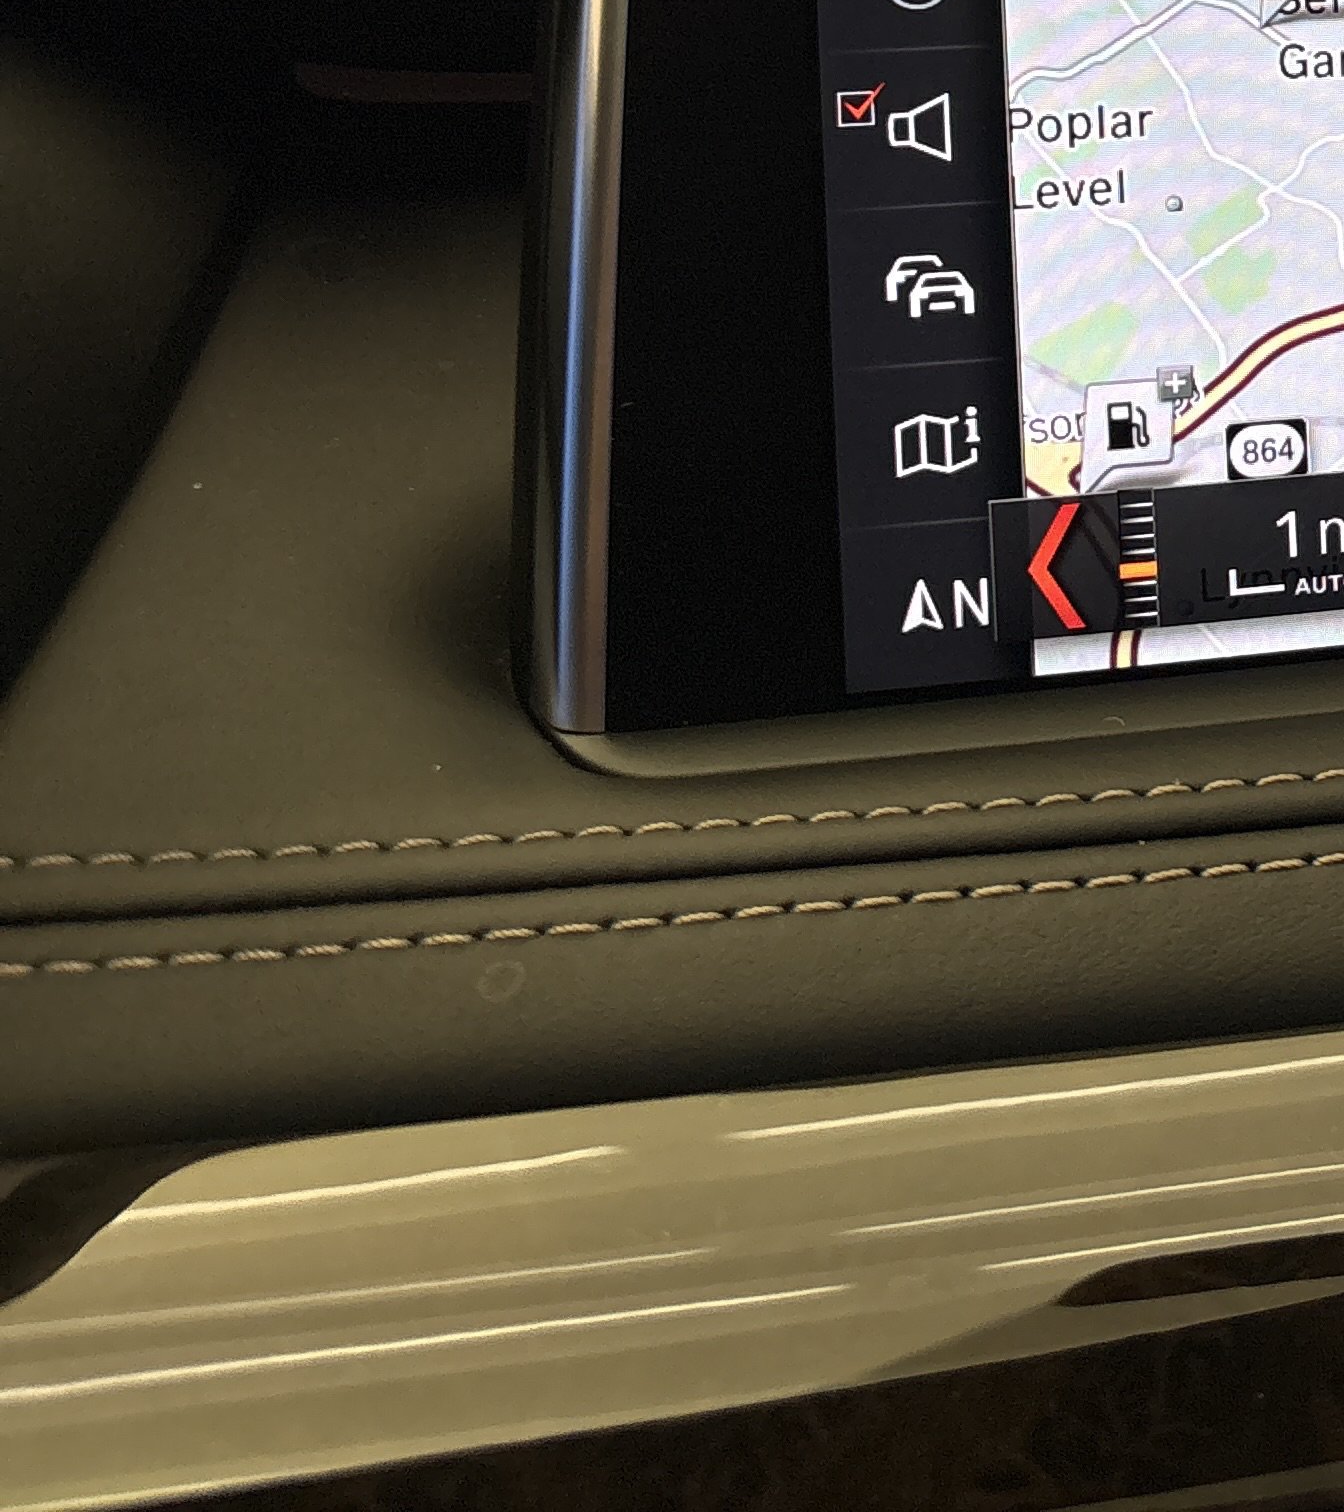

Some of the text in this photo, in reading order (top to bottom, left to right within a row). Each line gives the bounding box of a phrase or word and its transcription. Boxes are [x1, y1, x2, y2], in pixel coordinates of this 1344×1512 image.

[1009, 105, 1154, 148] Poplar
[1012, 168, 1126, 209] Level
[1243, 437, 1294, 464] 864
[1276, 510, 1298, 558] 1
[953, 577, 989, 628] N
